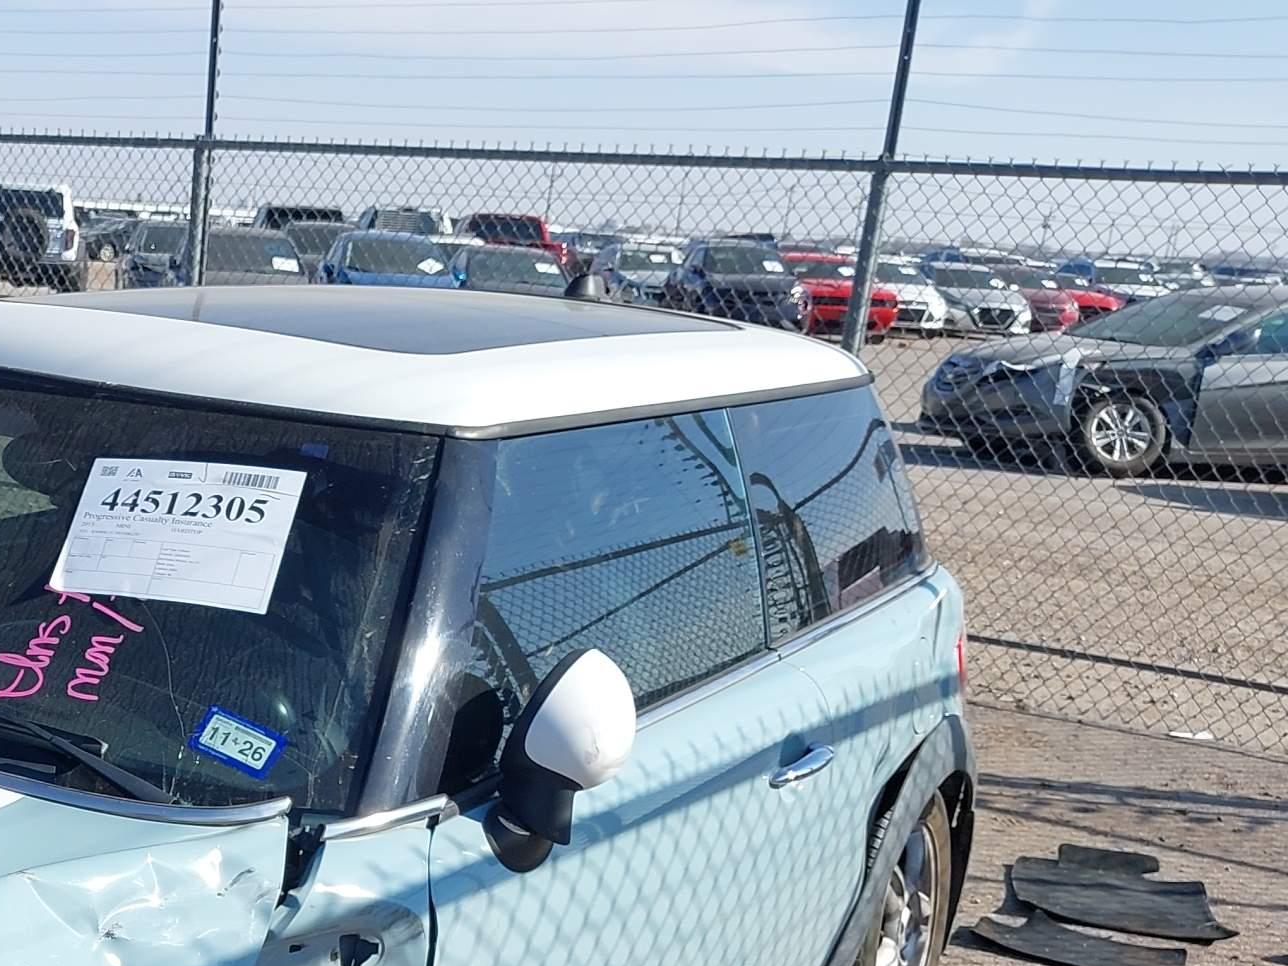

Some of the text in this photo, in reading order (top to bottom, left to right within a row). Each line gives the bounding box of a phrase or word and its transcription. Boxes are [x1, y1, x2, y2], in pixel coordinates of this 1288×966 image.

[100, 487, 270, 524] 44512305
[83, 511, 213, 528] Progressive Casualty Insurance
